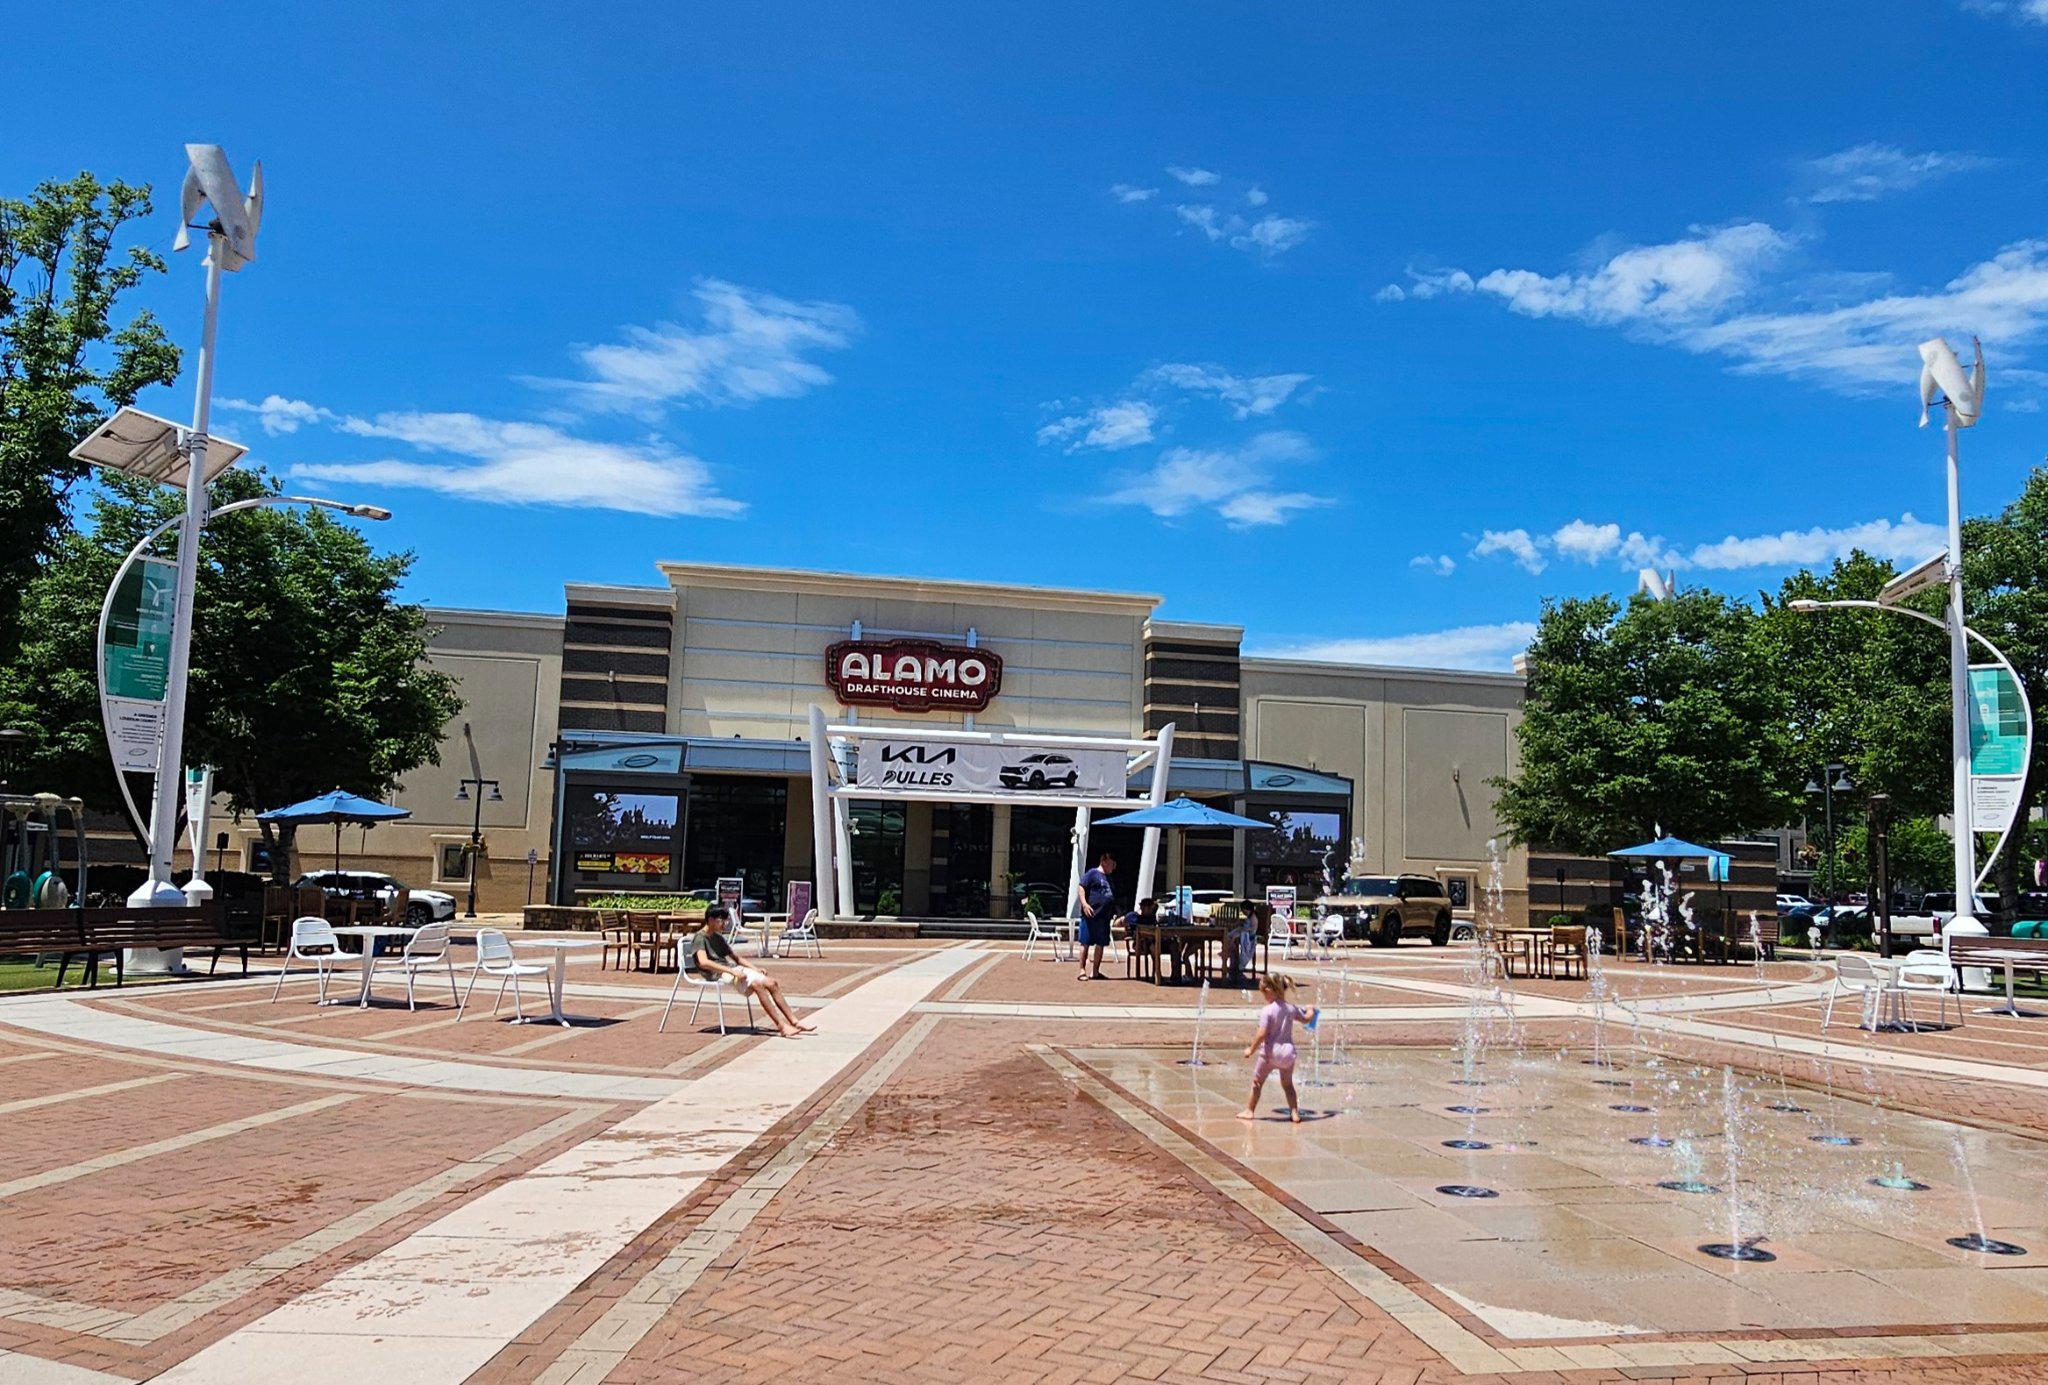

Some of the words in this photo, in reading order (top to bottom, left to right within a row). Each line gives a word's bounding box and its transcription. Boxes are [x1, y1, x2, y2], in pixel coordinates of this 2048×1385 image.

[841, 652, 987, 686] ALAMO
[847, 683, 927, 697] DRAFTHOUSE
[931, 688, 978, 699] CINEMA
[881, 745, 956, 765] KIA
